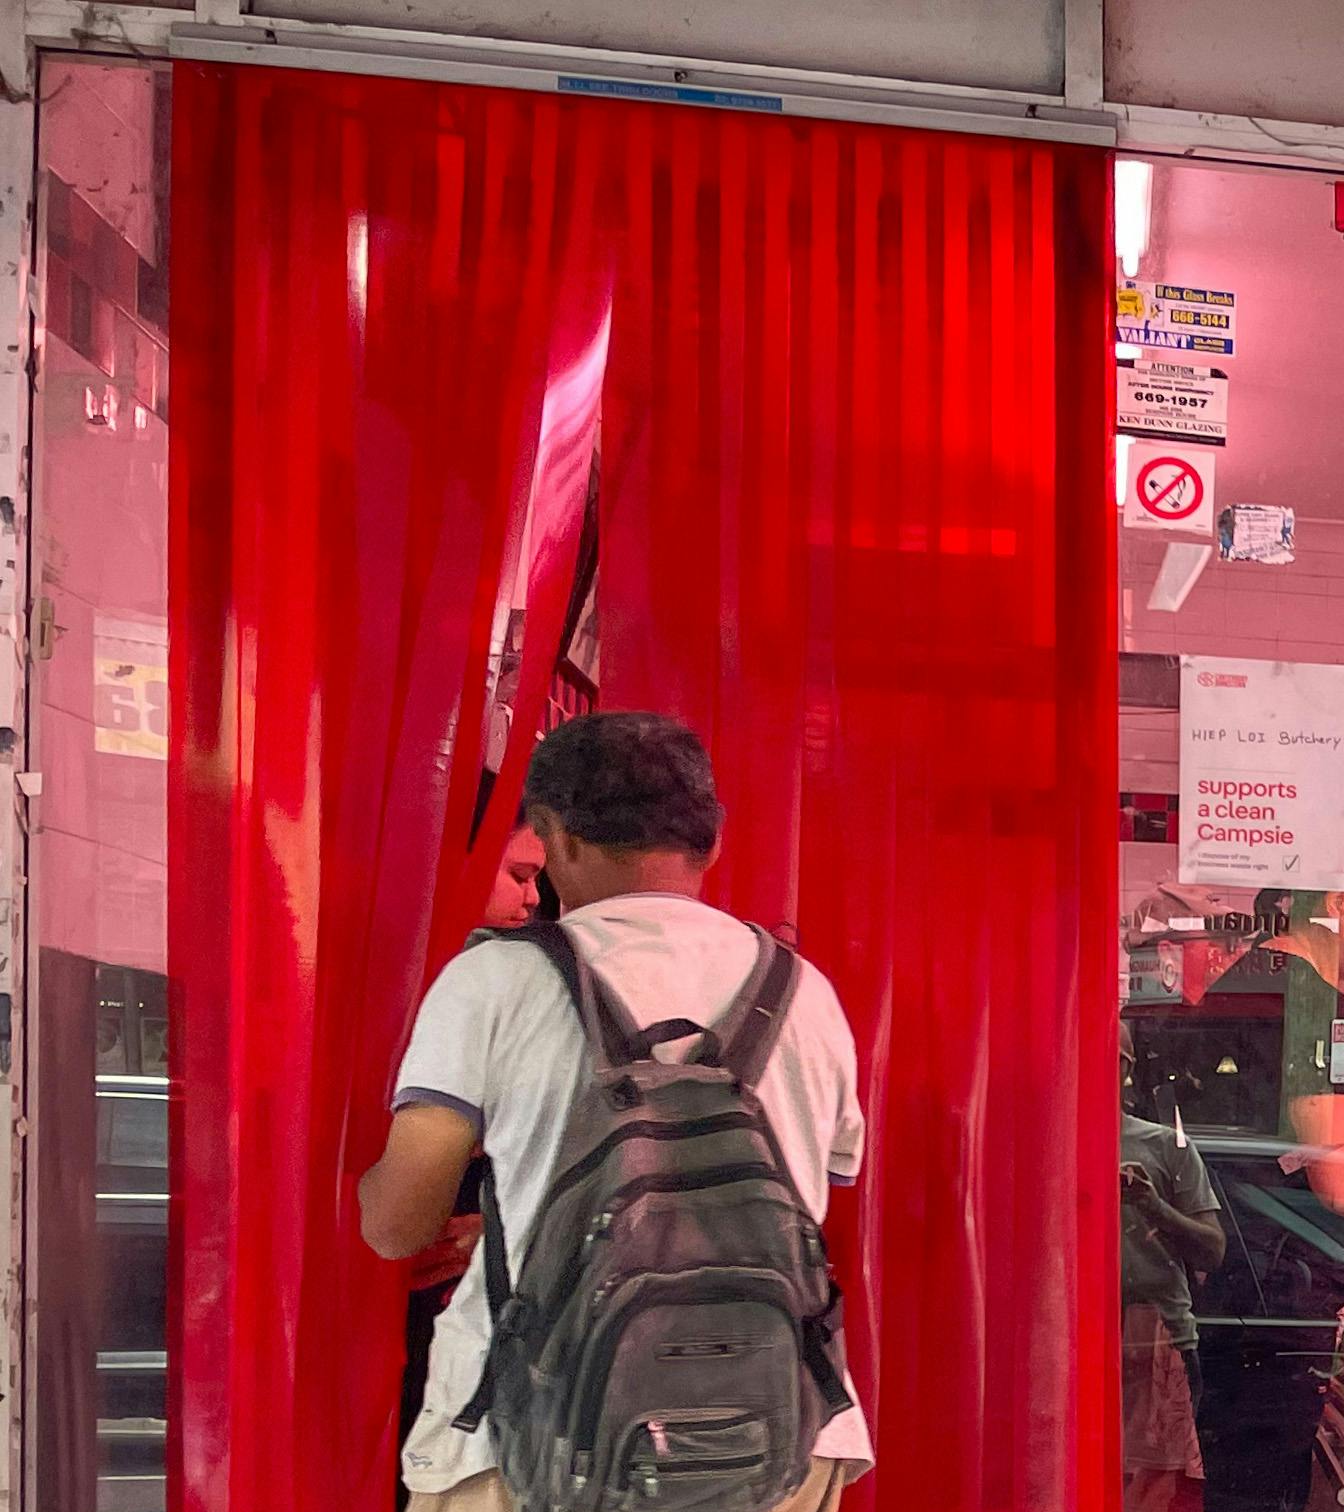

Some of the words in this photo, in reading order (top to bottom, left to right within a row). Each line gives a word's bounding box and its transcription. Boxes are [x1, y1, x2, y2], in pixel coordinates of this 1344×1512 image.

[1183, 290, 1204, 303] Glass
[1117, 327, 1190, 349] VALIANT
[1151, 363, 1194, 376] ATTENTION
[1119, 415, 1140, 425] KEN
[1144, 417, 1173, 429] DUNN
[1176, 421, 1222, 434] GLAZING
[1277, 731, 1342, 750] Butchery
[1197, 779, 1298, 800] supports
[1198, 803, 1210, 818] a
[1214, 800, 1275, 821] clean
[1197, 822, 1294, 847] Campsie
